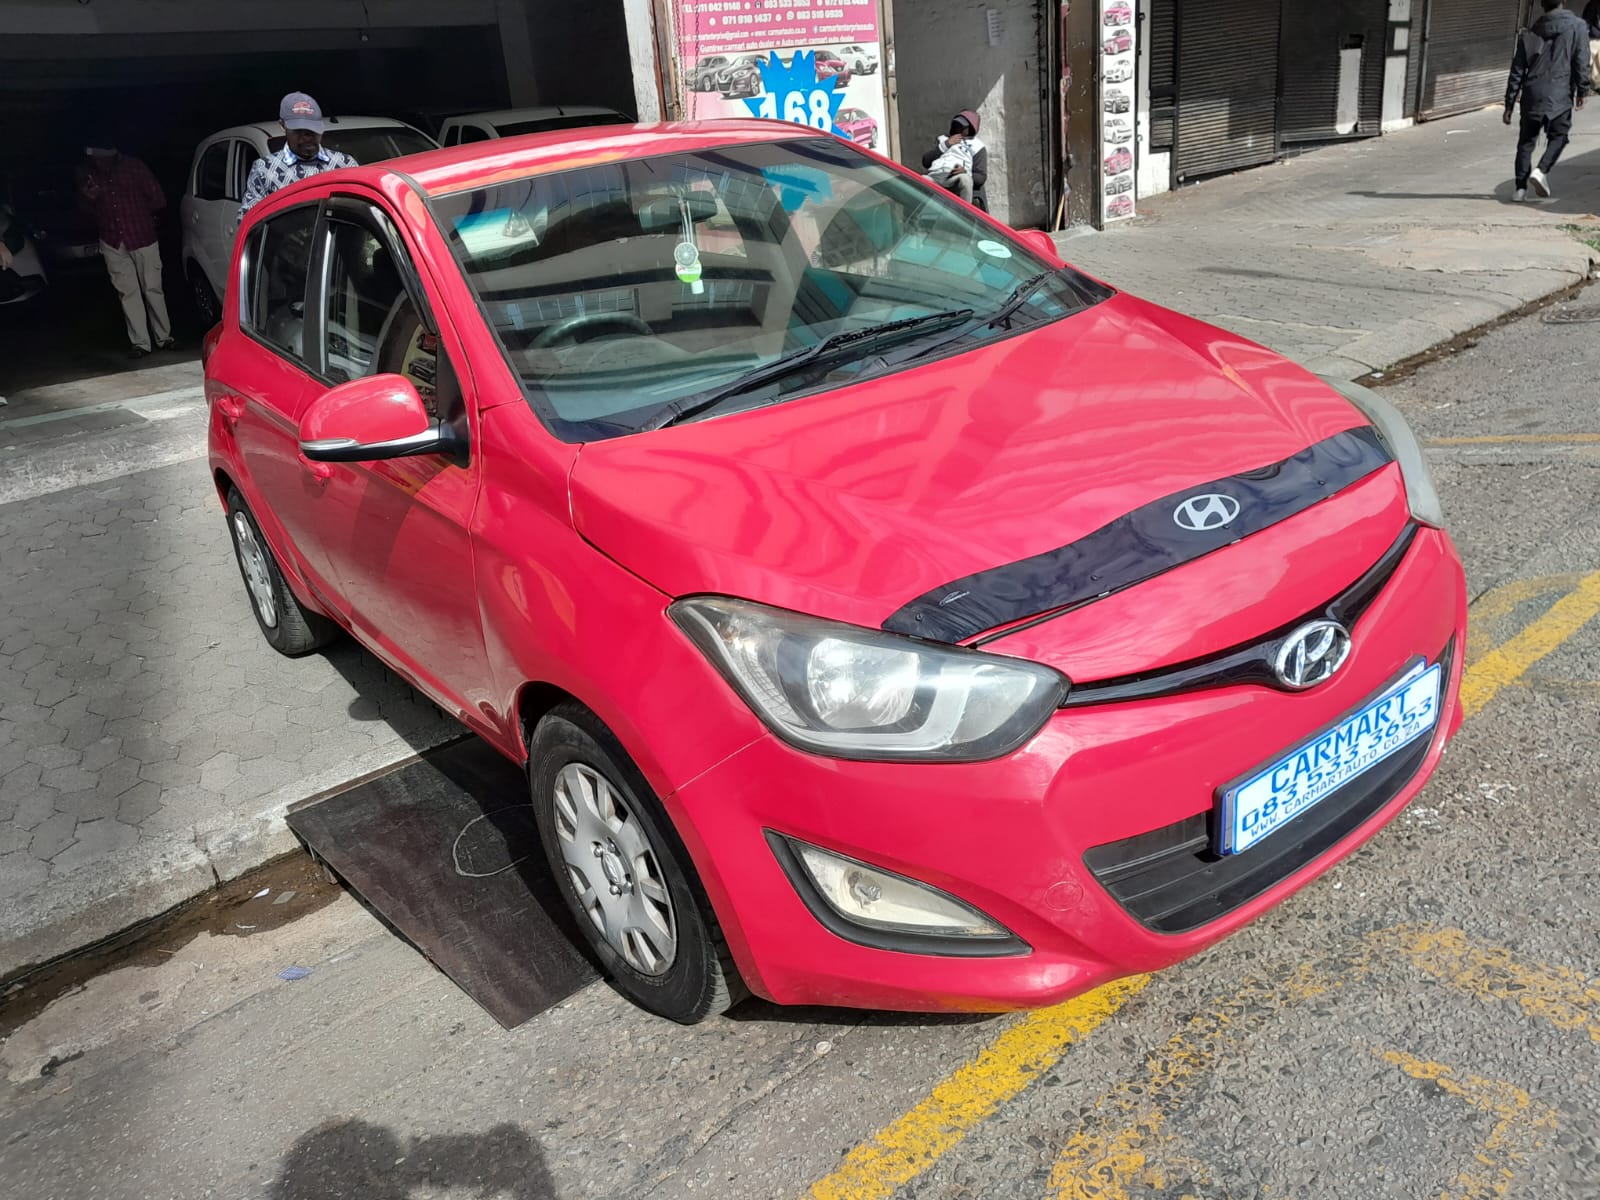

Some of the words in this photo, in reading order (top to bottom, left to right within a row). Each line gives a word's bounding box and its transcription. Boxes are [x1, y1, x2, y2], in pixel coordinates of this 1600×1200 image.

[1242, 782, 1298, 832] 083
[1307, 742, 1359, 789] 533
[1368, 696, 1432, 749] 3653
[1271, 687, 1411, 794] CARMART
